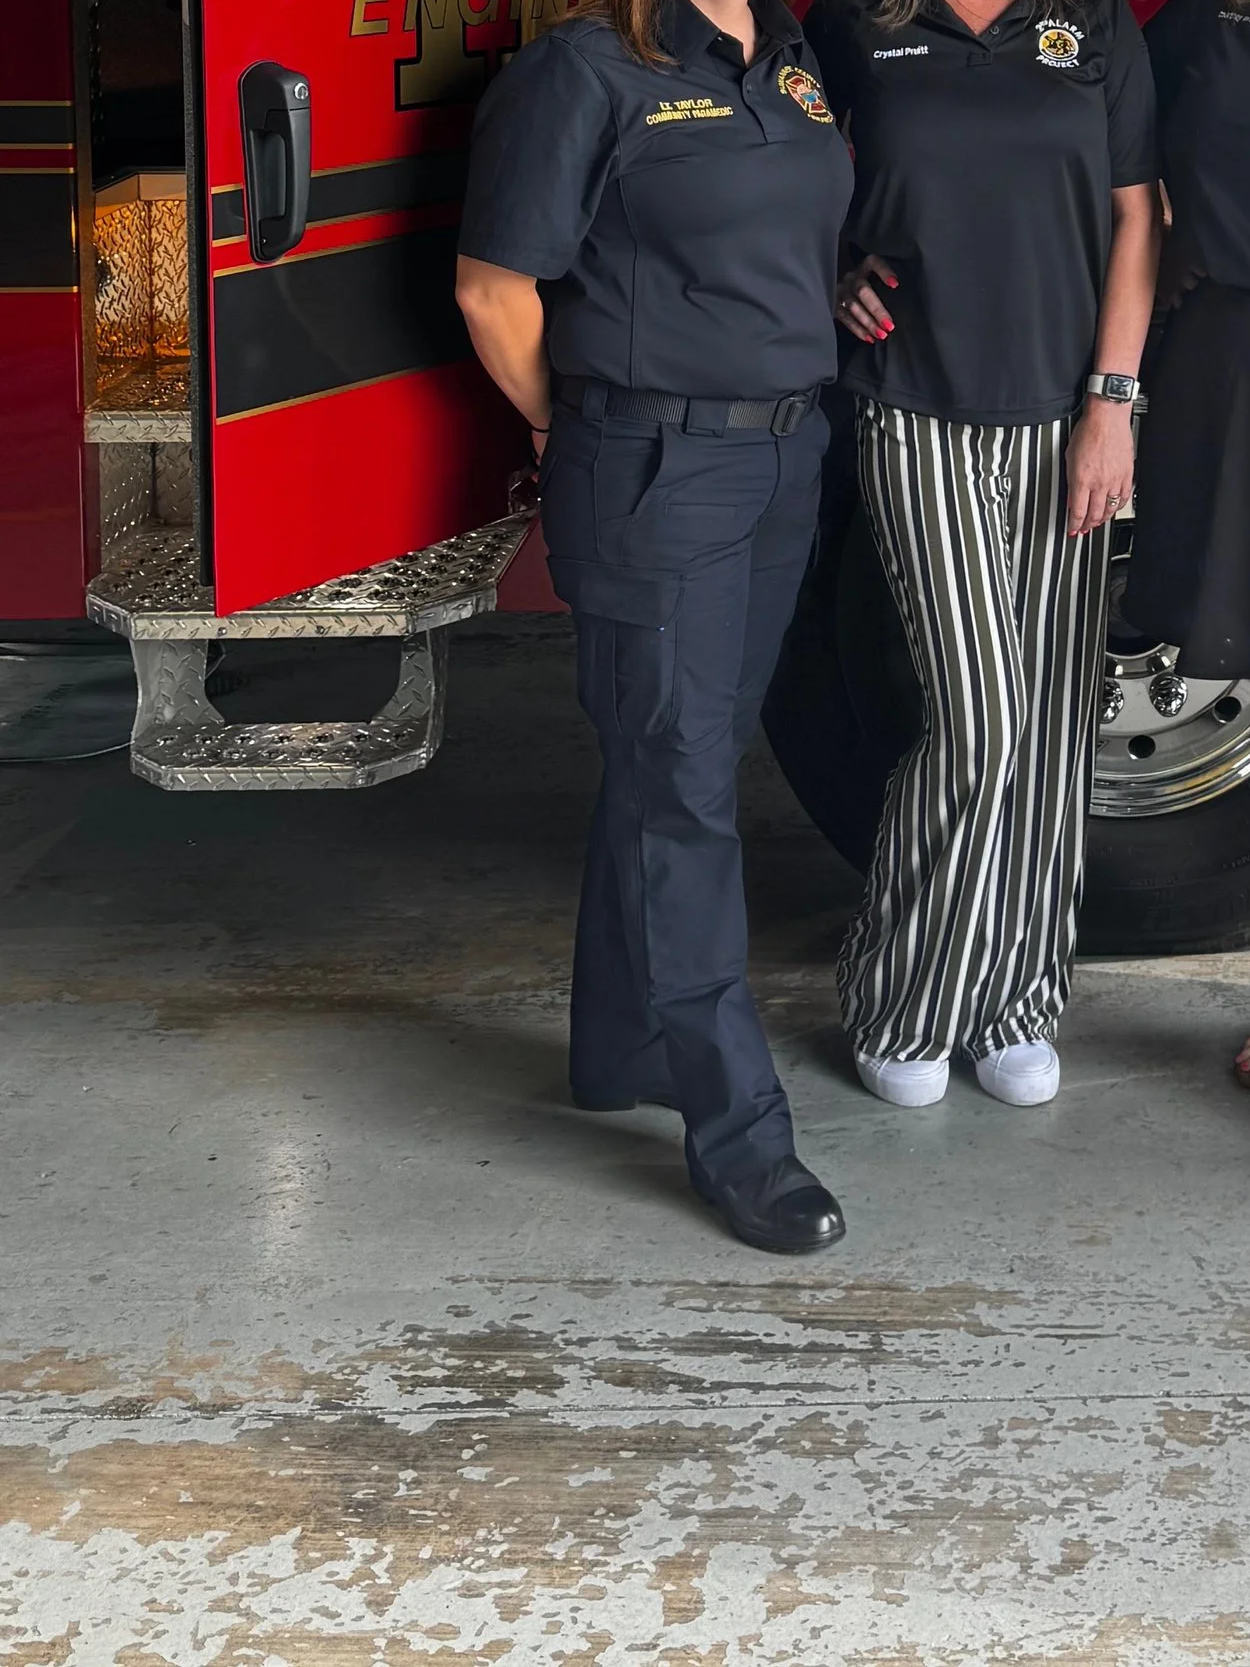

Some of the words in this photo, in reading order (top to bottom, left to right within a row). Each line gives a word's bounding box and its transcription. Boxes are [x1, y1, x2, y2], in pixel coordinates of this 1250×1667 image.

[1048, 18, 1085, 40] ALARM
[873, 46, 904, 60] Crystal
[1035, 54, 1080, 68] PROJECT
[673, 98, 714, 111] TAYLOR
[645, 109, 691, 126] COMMUNITY
